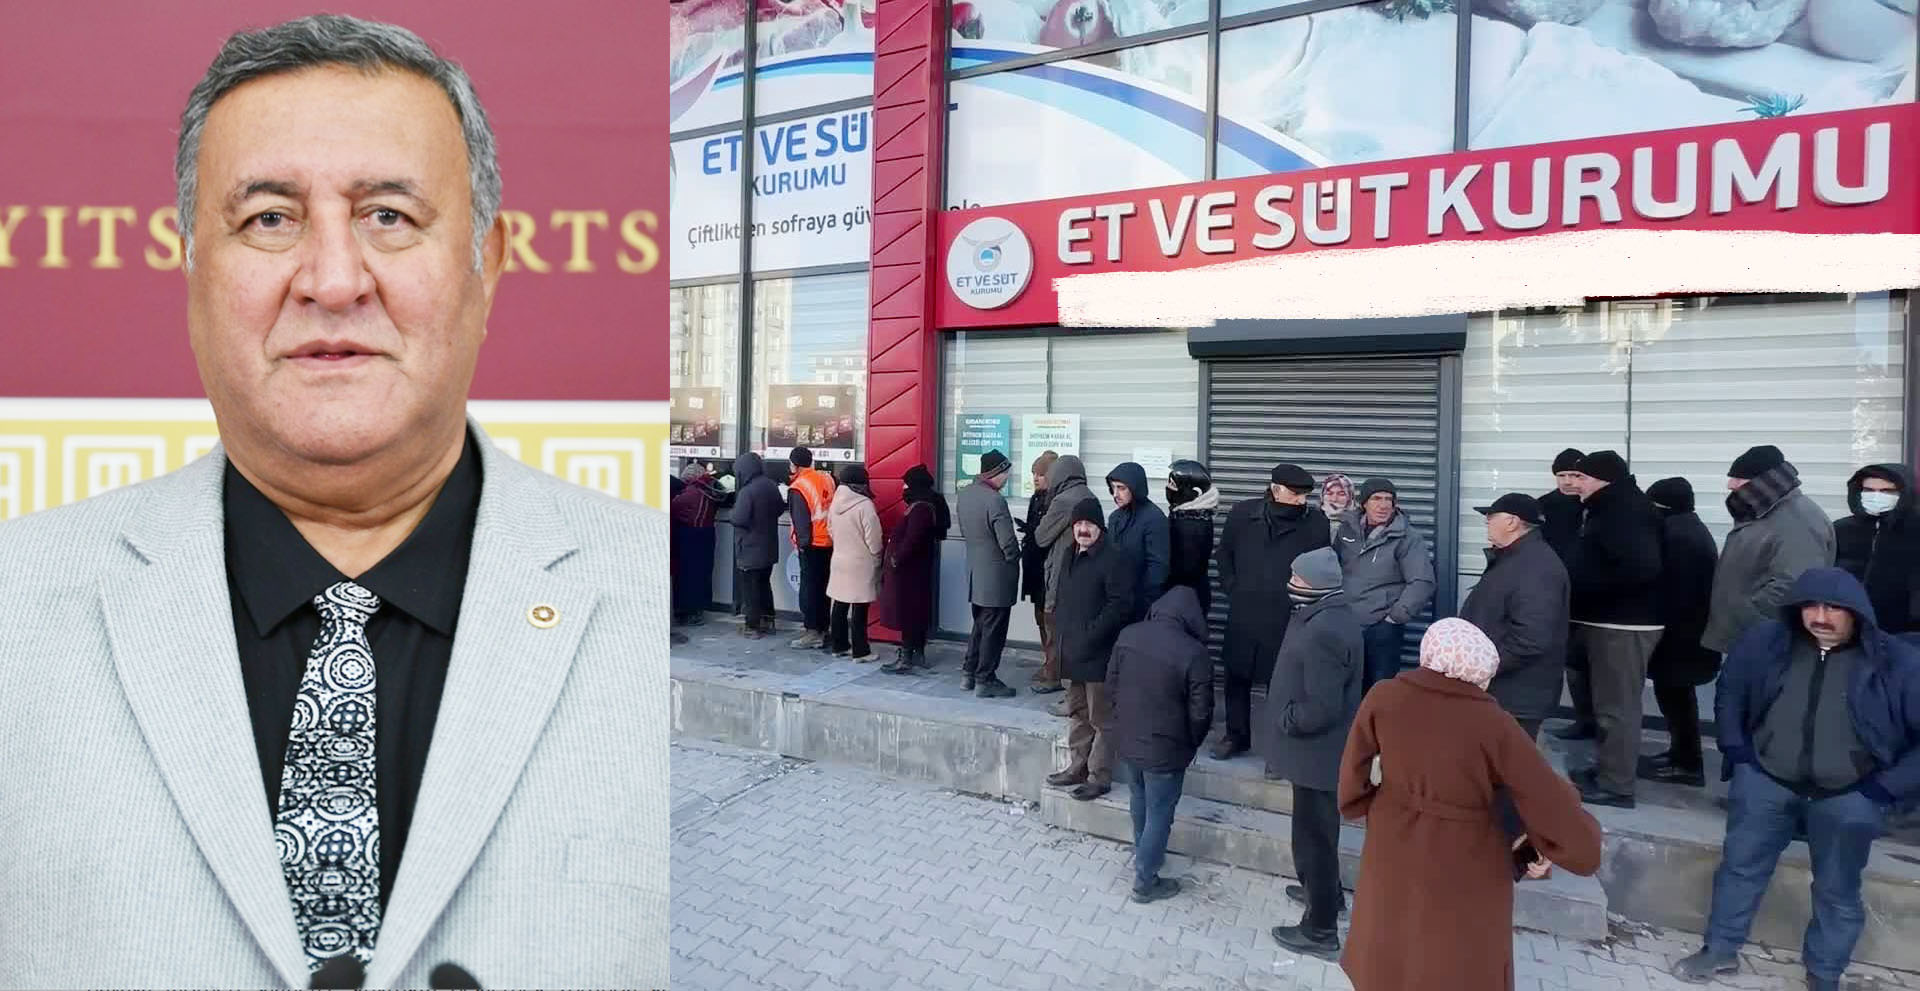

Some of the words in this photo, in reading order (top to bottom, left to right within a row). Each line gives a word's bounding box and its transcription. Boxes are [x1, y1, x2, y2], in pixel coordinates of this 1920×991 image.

[702, 135, 743, 176] ET
[759, 123, 808, 166] VE
[815, 111, 874, 158] SÜ
[752, 163, 847, 197] KURUMU
[1057, 202, 1136, 265] ET
[1149, 191, 1237, 258] VE
[1251, 172, 1410, 250] SÜT
[1427, 122, 1892, 237] KURUMU
[771, 209, 836, 235] sofraya
[956, 276, 972, 288] ET
[974, 274, 990, 286] VE
[991, 272, 1018, 286] SÜT
